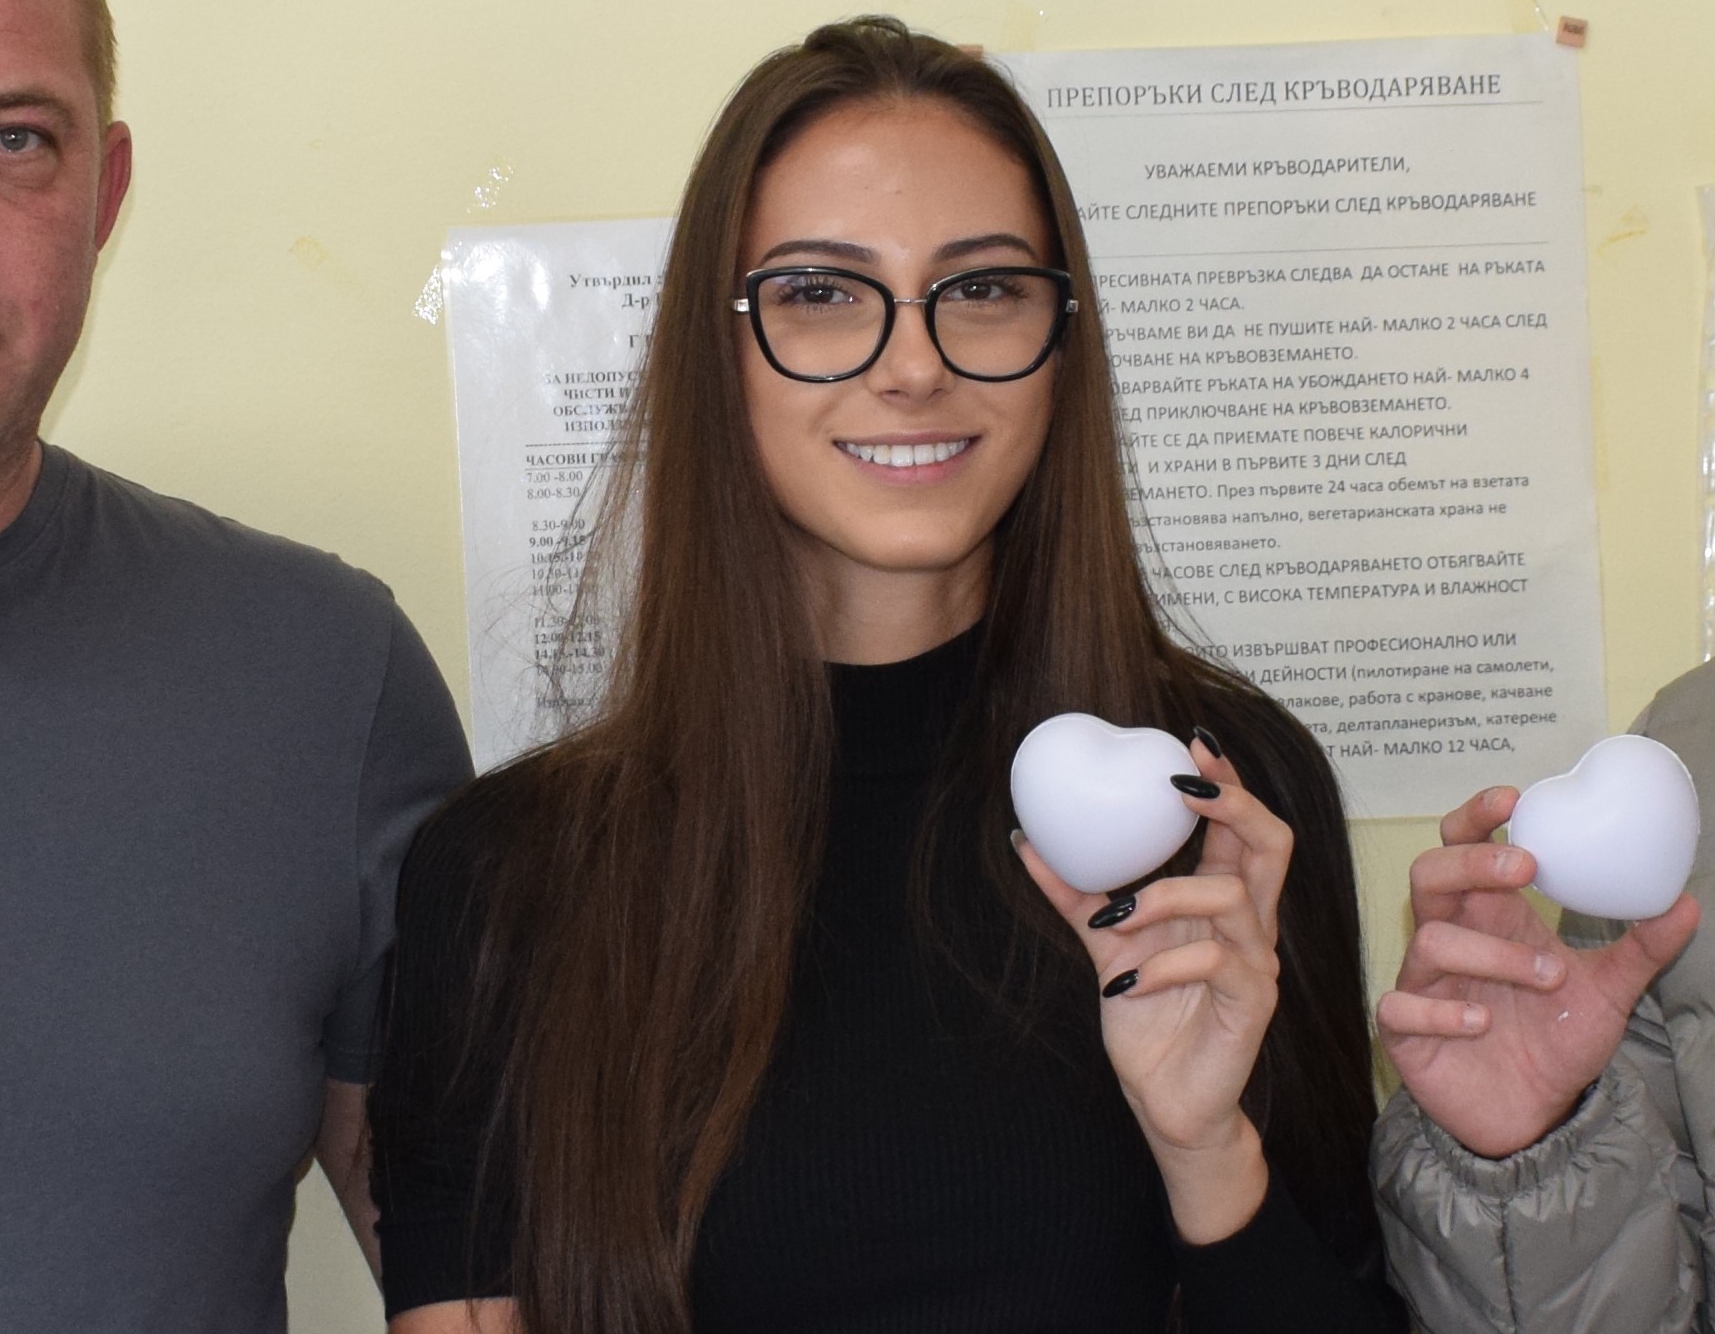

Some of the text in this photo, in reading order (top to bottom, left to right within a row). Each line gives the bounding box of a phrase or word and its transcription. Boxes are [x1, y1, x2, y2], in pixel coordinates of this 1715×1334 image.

[1047, 74, 1501, 108] ПРЕПОРЪКИ СЛЕД КРЪВОДАРЯВАНЕ
[1144, 156, 1411, 179] УВАЖАЕМИ КРЪВОДАРИТЕЛИ,
[1077, 191, 1537, 221] АЙТЕ СЛЕДНИТЕ ПРЕПОРЪКИ СЛЕД КРЪВОДАРЯВАНЕ
[570, 274, 652, 289] Утвърдил
[1197, 268, 1286, 285] ПРЕВРЪЗКА
[1291, 266, 1353, 283] СЛЕДВА
[1361, 266, 1383, 281] ДА
[1388, 263, 1449, 279] ОСТАНЕ
[1458, 262, 1480, 276] НА
[1485, 260, 1546, 275] РЪКАТА
[622, 293, 650, 309] Д-р
[1121, 297, 1244, 314] МАЛКО 2 ЧАСА.
[1107, 313, 1548, 342] РЪЧВАМЕ ВИ ДА НЕ ПУШИТЕ НАЙ- МАЛКО 2 ЧАСА СЛЕД
[1180, 346, 1358, 366] НА КРЪВОВЗЕМАНЕТО.
[565, 370, 637, 385] НЕДОПУС
[1208, 368, 1530, 393] РЪКАТА НА УБОЖДАНЕТО НАЙ- МАЛКО 4
[564, 389, 614, 401] ЧИСТИ
[1147, 396, 1451, 421] ПРИКЛЮЧВАНЕ НА КРЪВОВЗЕМАНЕТО.
[1163, 424, 1468, 449] СЕ ДА ПРИЕМАТЕ ПОВЕЧЕ КАЛОРИЧНИ
[526, 453, 586, 466] ЧАСОВИ
[1148, 461, 1159, 474] И
[1164, 458, 1218, 473] ХРАНИ
[1222, 458, 1232, 471] В
[1236, 455, 1307, 471] ПЪРВИТЕ
[1313, 455, 1321, 468] 3
[1325, 453, 1360, 469] ДНИ
[1365, 451, 1407, 466] СЛЕД
[526, 471, 583, 483] 7.00 -8.00
[1217, 476, 1529, 500] През първите 24 часа обемът на взетата
[527, 487, 581, 500] 8.00-8.30
[1232, 503, 1507, 525] напълно, вегетарианската храна не
[1152, 551, 1526, 580] ЧАСОВЕ СЛЕД КРЪВОДАРЯВАНЕТО ОТБЯГВАЙТЕ
[1224, 578, 1528, 604] С ВИСОКА ТЕМПЕРАТУРА И ВЛАЖНОСТ
[1234, 633, 1517, 658] ИЗВЪРШВАТ ПРОФЕСИОНАЛНО ИЛИ
[1260, 667, 1347, 685] ДЕЙНОСТИ
[1351, 662, 1449, 681] (пилотиране
[1454, 662, 1472, 674] на
[1476, 659, 1554, 674] самолети,
[1349, 686, 1553, 708] работа с кранове, качване
[1336, 710, 1558, 734] делтапланеризъм, катерене
[1340, 741, 1379, 759] НАЙ-
[1383, 740, 1443, 756] МАЛКО
[1448, 739, 1465, 753] 12
[1469, 737, 1516, 753] ЧАСА,
